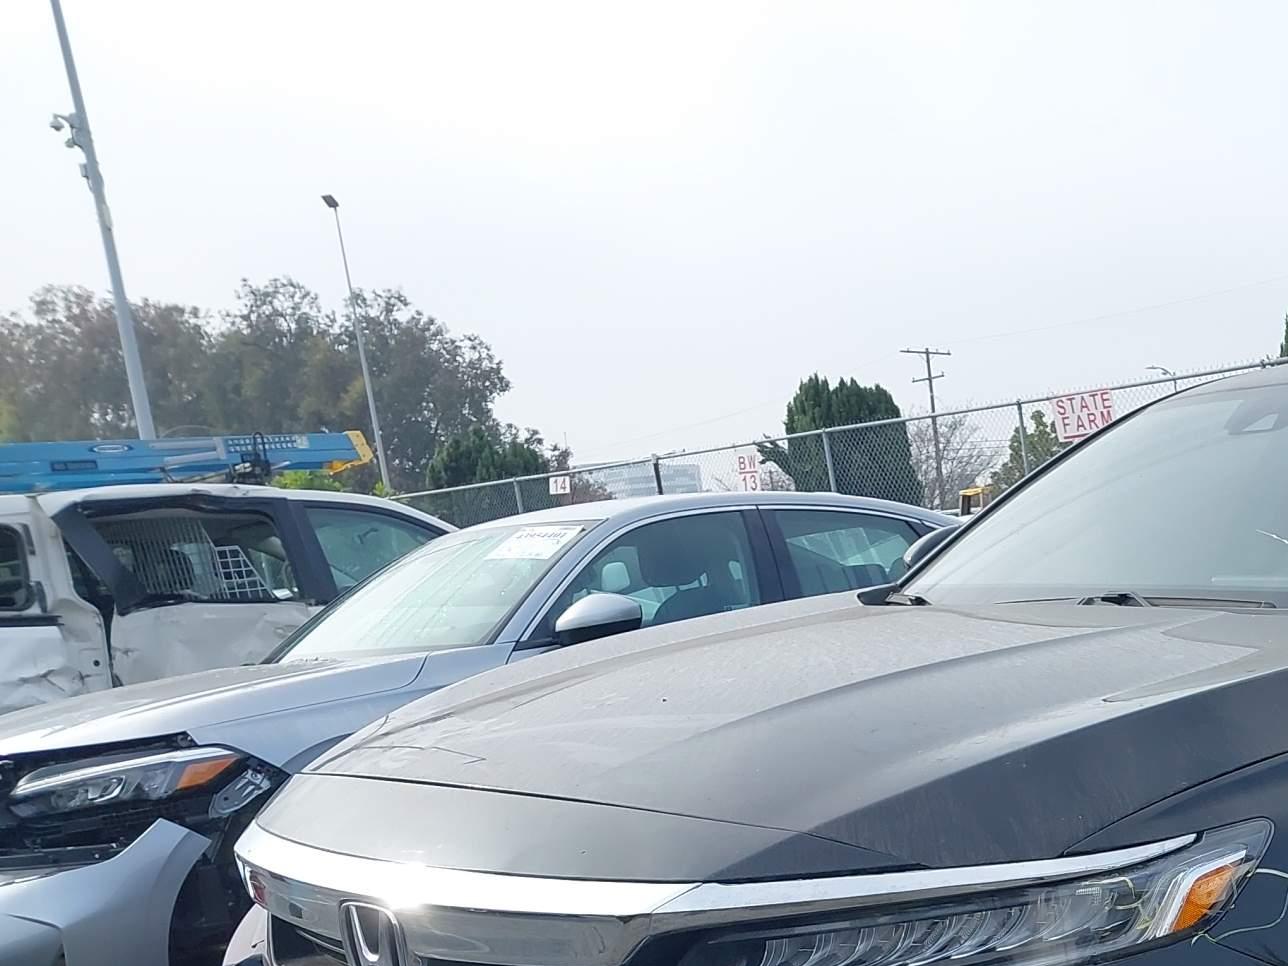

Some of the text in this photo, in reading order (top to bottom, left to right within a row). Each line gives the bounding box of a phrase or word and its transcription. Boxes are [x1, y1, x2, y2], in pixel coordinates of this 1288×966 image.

[1056, 391, 1113, 416] STATE
[1061, 410, 1113, 433] FARM
[738, 455, 756, 470] BW
[553, 478, 567, 493] 14
[742, 474, 758, 492] 13
